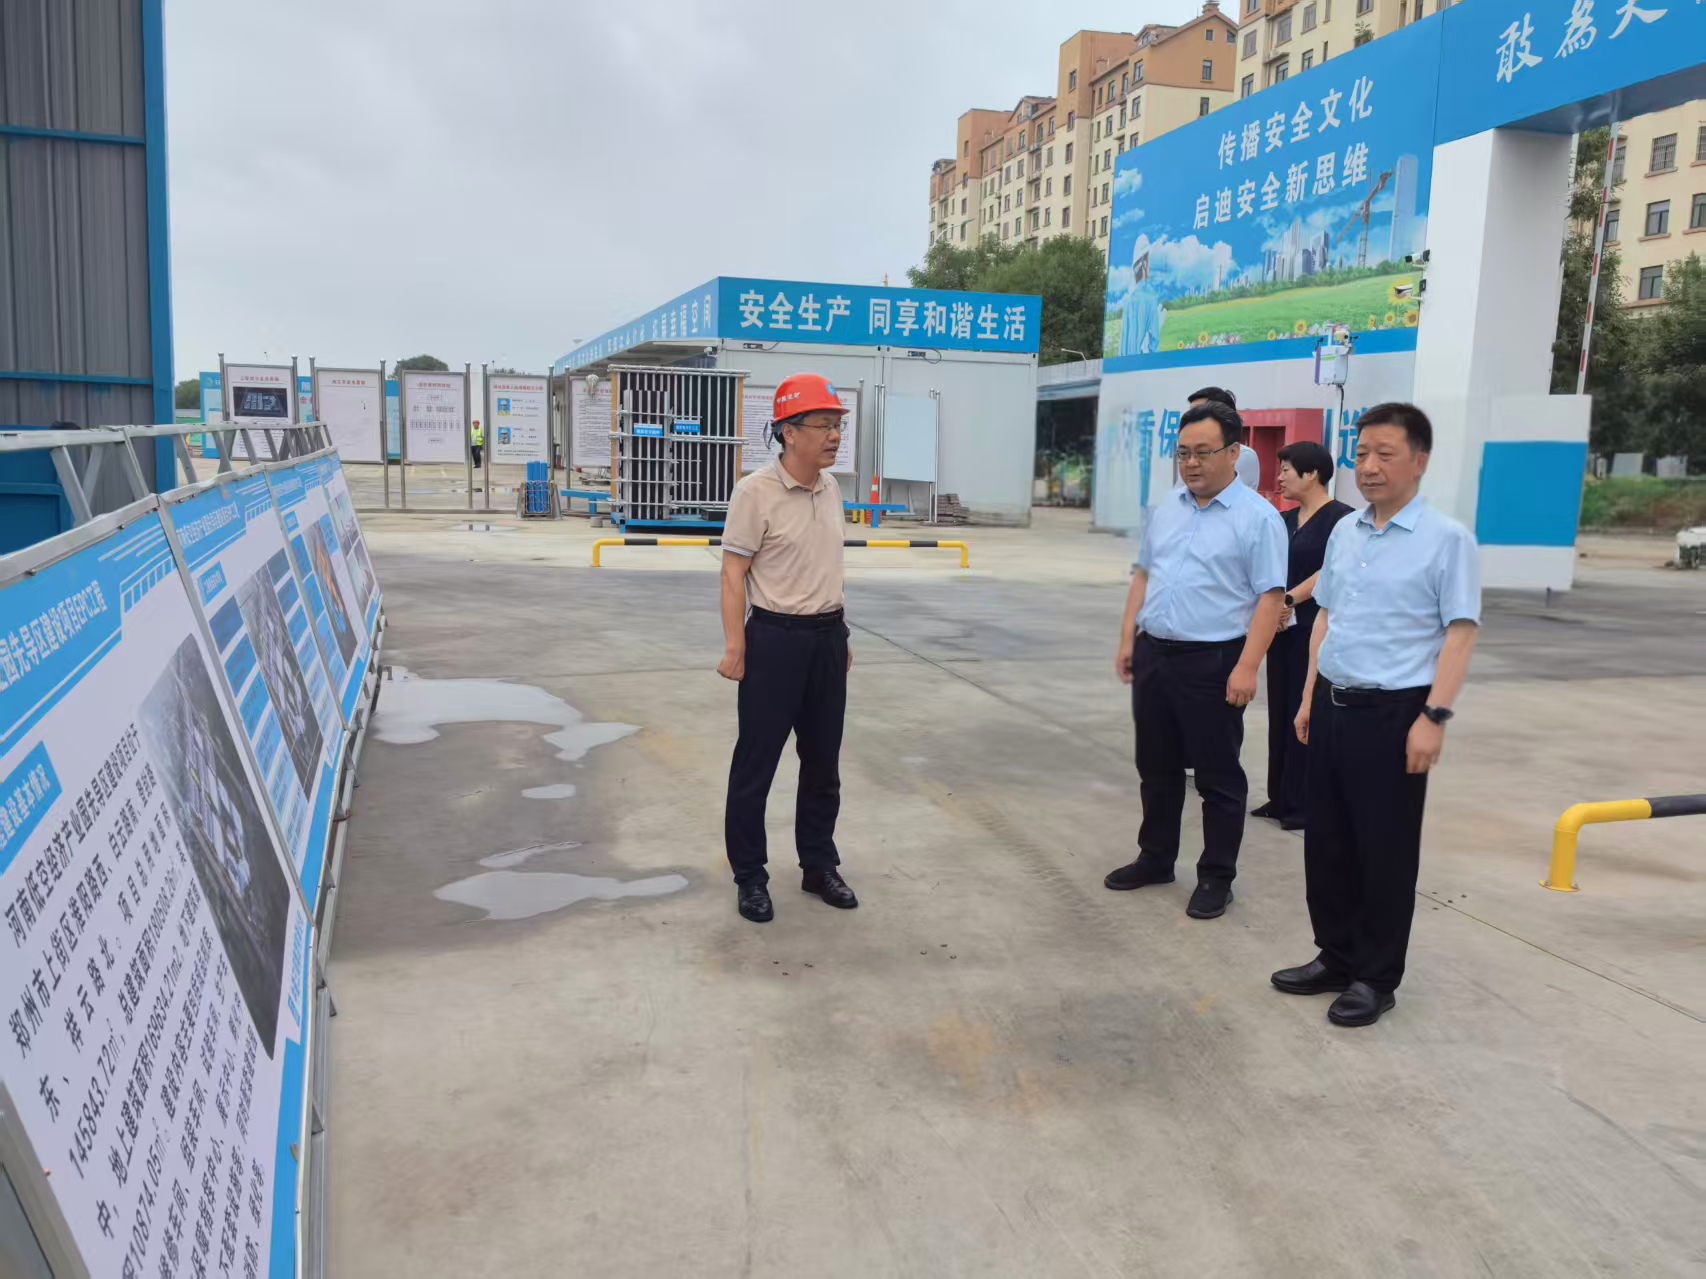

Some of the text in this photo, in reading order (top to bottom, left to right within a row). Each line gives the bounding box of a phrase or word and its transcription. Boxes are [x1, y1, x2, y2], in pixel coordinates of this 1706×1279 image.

[1218, 76, 1374, 170] 传播安全文化
[1193, 141, 1369, 230] 启迪安全新思维
[739, 289, 1026, 341] 安全生产 同享和谐生活
